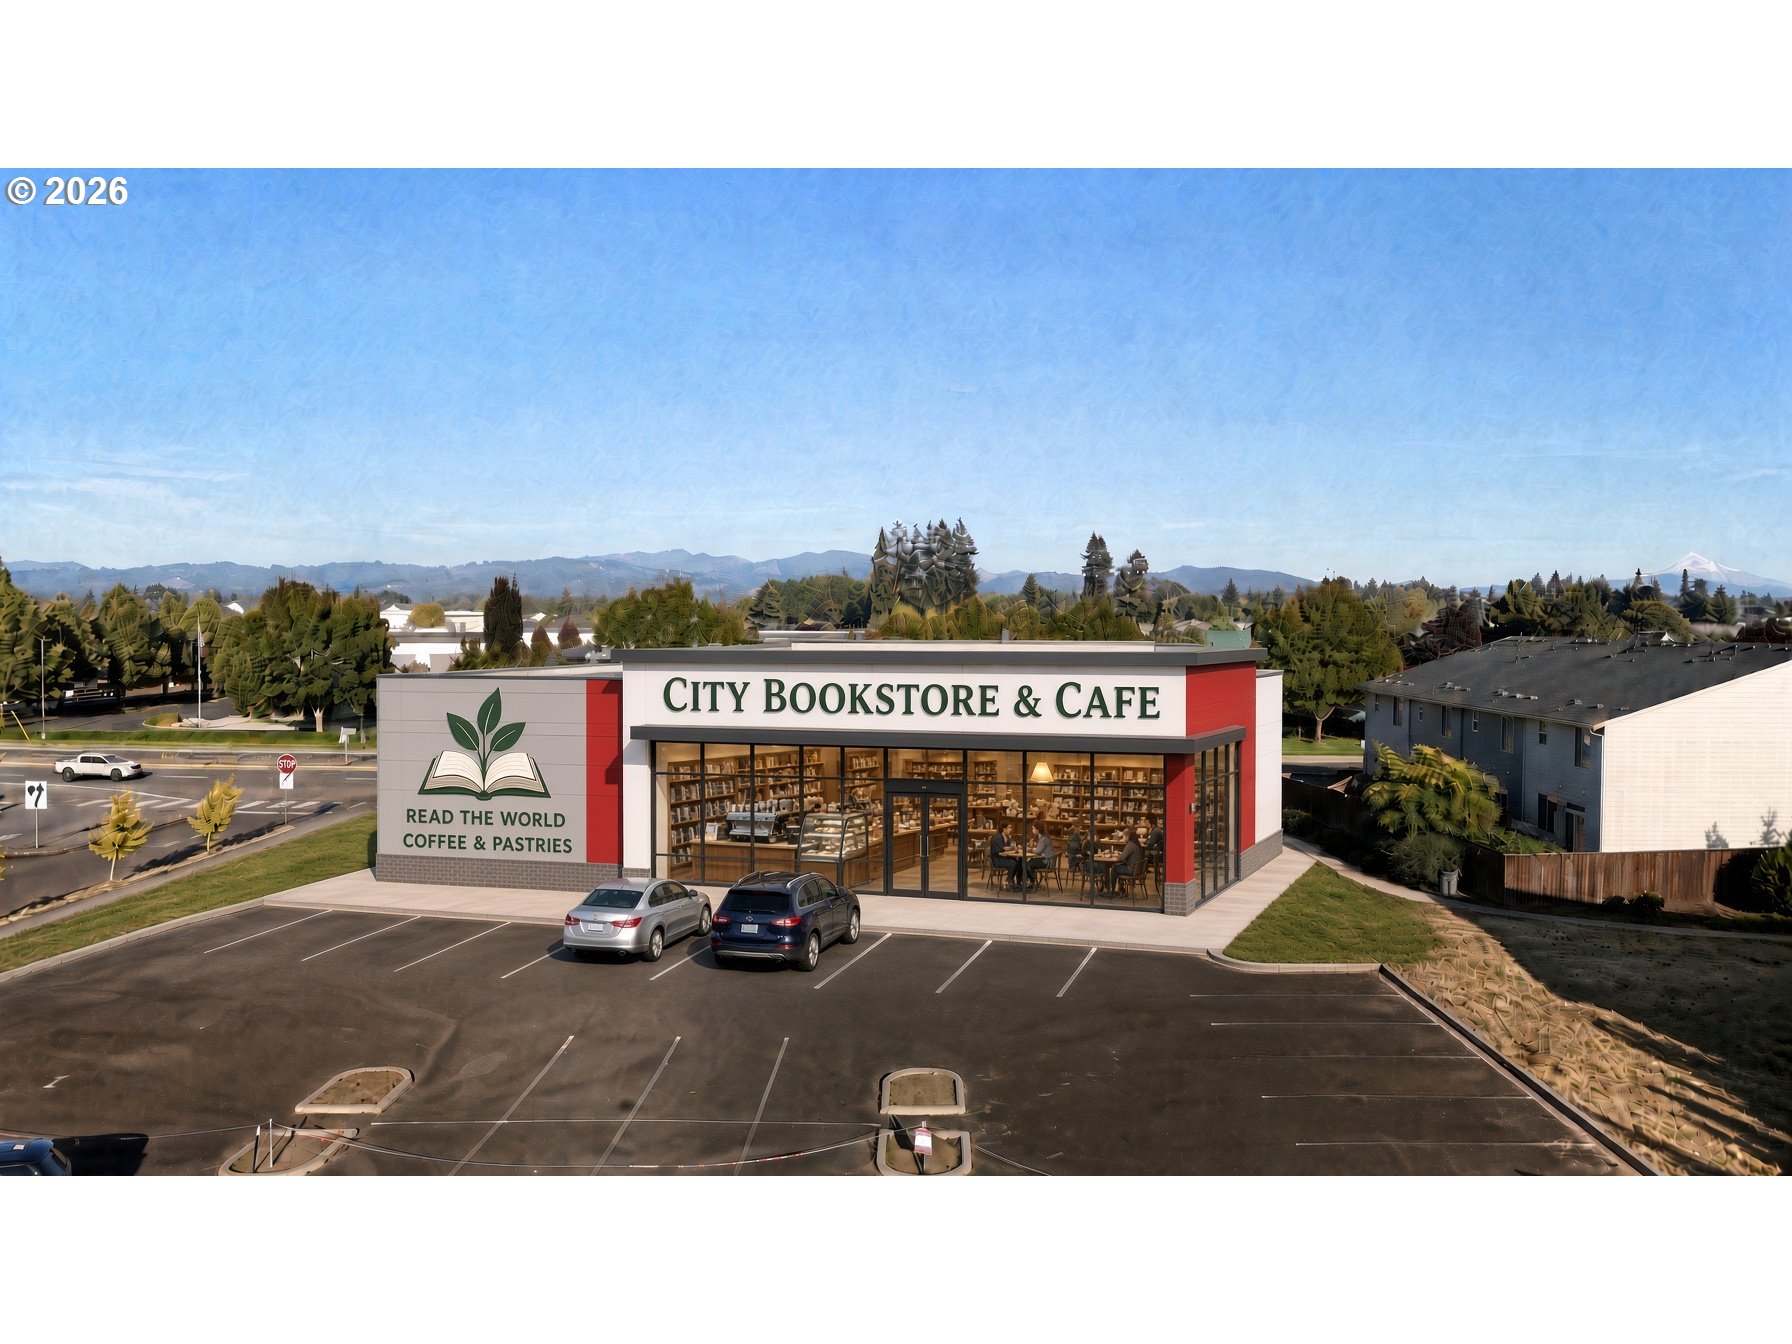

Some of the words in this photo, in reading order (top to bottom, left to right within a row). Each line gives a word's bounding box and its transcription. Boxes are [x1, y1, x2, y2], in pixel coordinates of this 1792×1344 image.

[663, 677, 750, 713] CITY
[764, 678, 1000, 716] BOOKSTORE
[1013, 684, 1043, 718] &
[1055, 681, 1161, 719] CAFE
[279, 760, 296, 769] STOP
[406, 808, 454, 824] READ
[460, 810, 494, 826] THE
[500, 811, 566, 827] WORLD
[403, 833, 467, 850] COFFEE
[473, 835, 487, 851] &
[493, 836, 573, 854] PASTRIES
